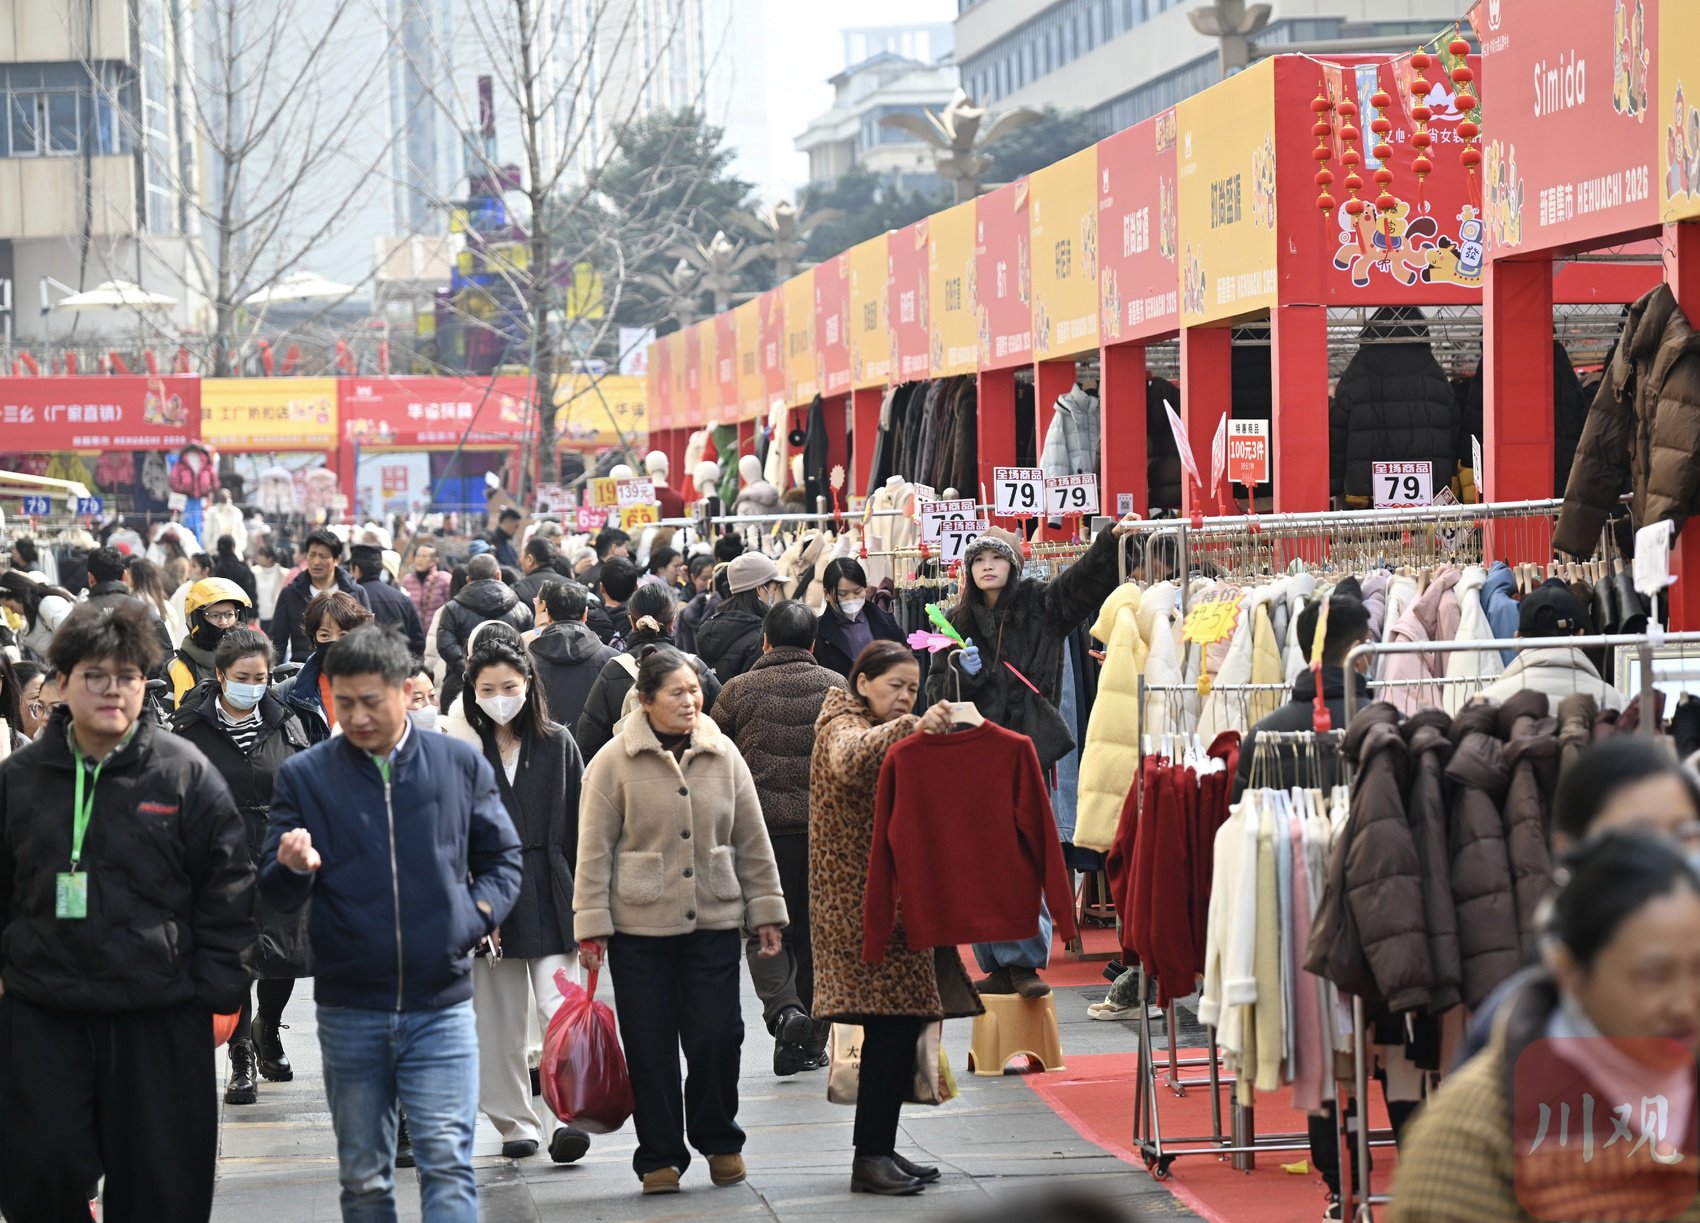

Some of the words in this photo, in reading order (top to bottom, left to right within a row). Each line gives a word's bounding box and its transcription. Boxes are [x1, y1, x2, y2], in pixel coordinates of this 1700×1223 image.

[1533, 49, 1586, 118] Simida
[1539, 182, 1574, 226] 新春集市
[1577, 172, 1622, 215] HEHUACHI
[1625, 164, 1649, 204] 2026
[1230, 440, 1265, 460] 100元3件
[997, 468, 1042, 481] 全场商品
[1374, 463, 1430, 474] 全场商品
[1045, 474, 1094, 488] 全场商品
[1384, 475, 1420, 501] 79
[1005, 482, 1035, 508] 79
[1054, 486, 1087, 509] 79
[28, 501, 47, 514] 79
[80, 501, 99, 514] 79
[922, 501, 974, 514] 全场商品
[942, 521, 987, 531] 全场商品
